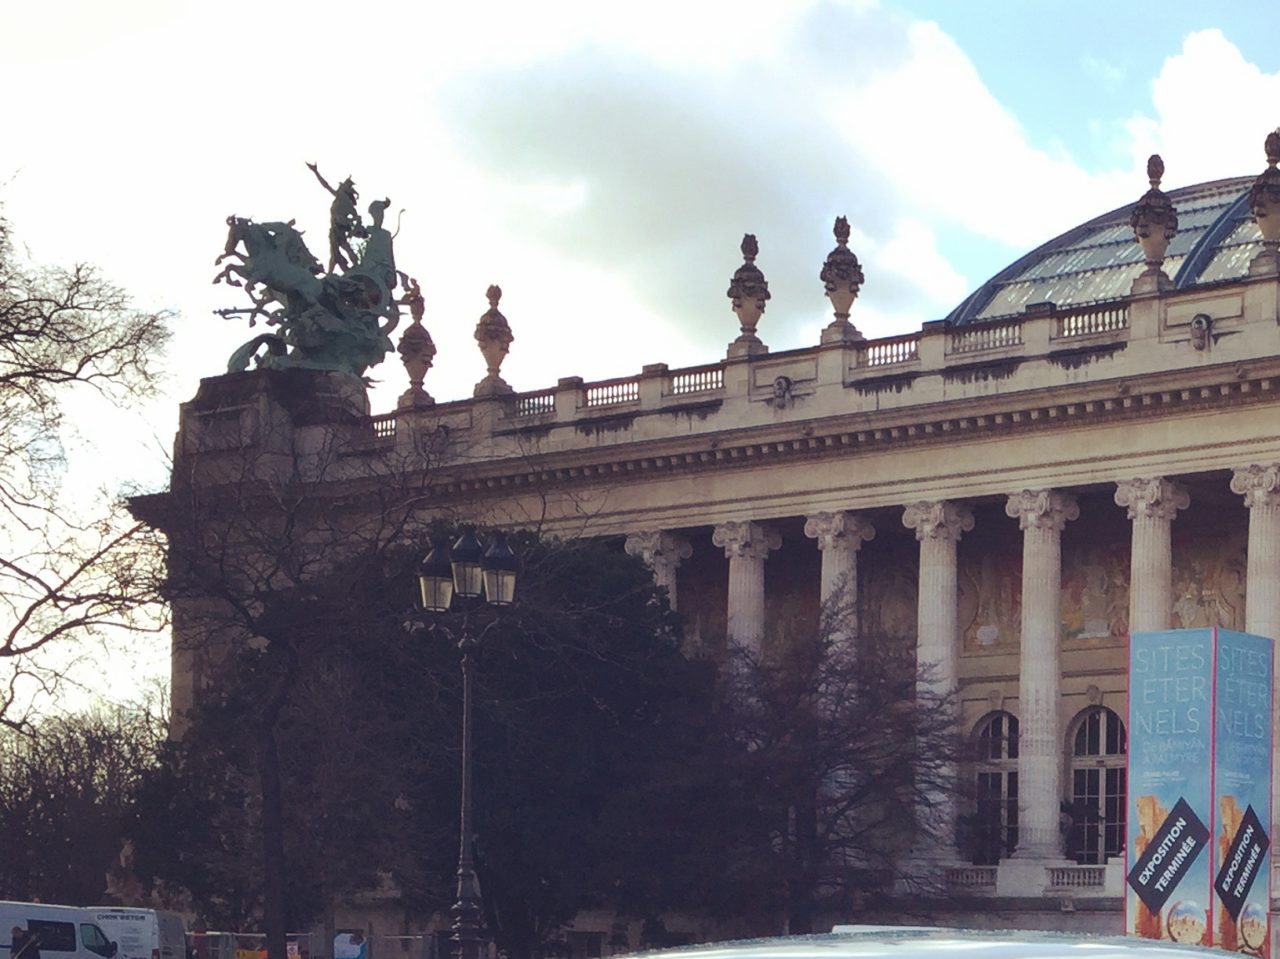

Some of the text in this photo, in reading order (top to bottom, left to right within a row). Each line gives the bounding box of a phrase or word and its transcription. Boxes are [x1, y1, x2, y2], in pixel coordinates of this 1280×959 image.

[1136, 644, 1205, 673] SITES
[1219, 644, 1268, 678] SITES
[1135, 707, 1200, 735] NELS
[1219, 708, 1265, 739] NELS
[1138, 817, 1187, 885] EXPOSITION
[1154, 835, 1197, 892] TERMINÉE
[1222, 824, 1255, 892] EXPOSITION
[1233, 843, 1261, 898] TERMINÉE
